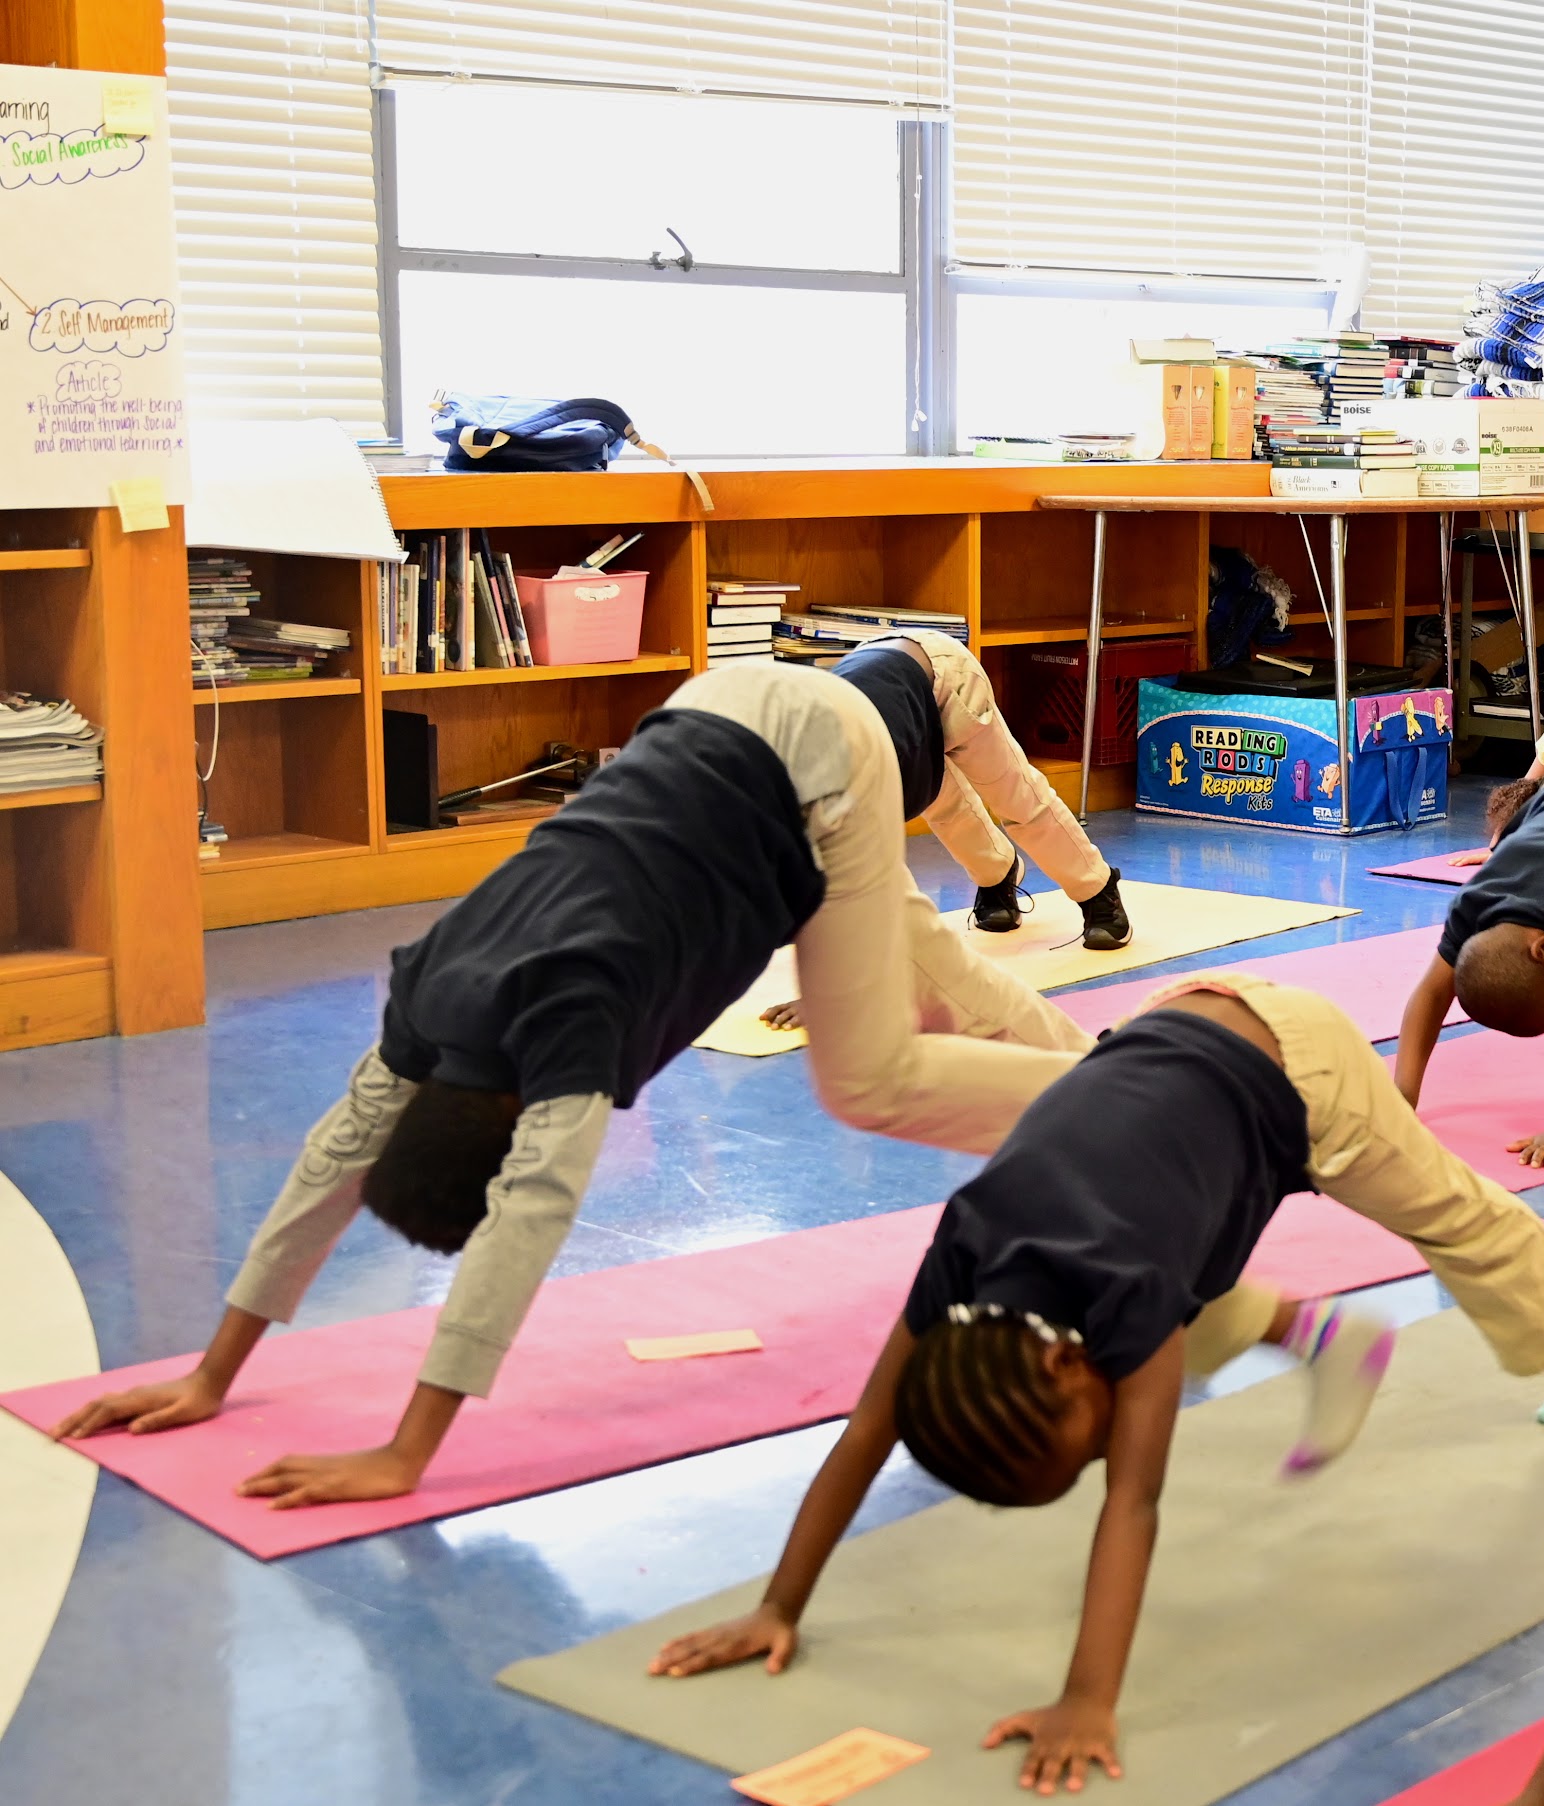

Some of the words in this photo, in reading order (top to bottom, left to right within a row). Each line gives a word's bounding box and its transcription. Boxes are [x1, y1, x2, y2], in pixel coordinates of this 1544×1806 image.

[0, 101, 50, 137] arning
[12, 141, 53, 167] Social
[58, 309, 81, 338] Self
[87, 308, 169, 339] Management
[67, 370, 109, 393] Article
[37, 394, 97, 420] Promoting
[101, 398, 118, 412] the
[51, 416, 95, 434] children
[35, 435, 55, 454] and
[59, 435, 116, 453] emotional
[1195, 729, 1278, 751] READING
[1203, 751, 1266, 771] RODS
[1202, 773, 1273, 806] Response
[1248, 795, 1273, 811] Kits
[1313, 806, 1333, 817] ETA
[1315, 815, 1341, 823] Cuisenair
